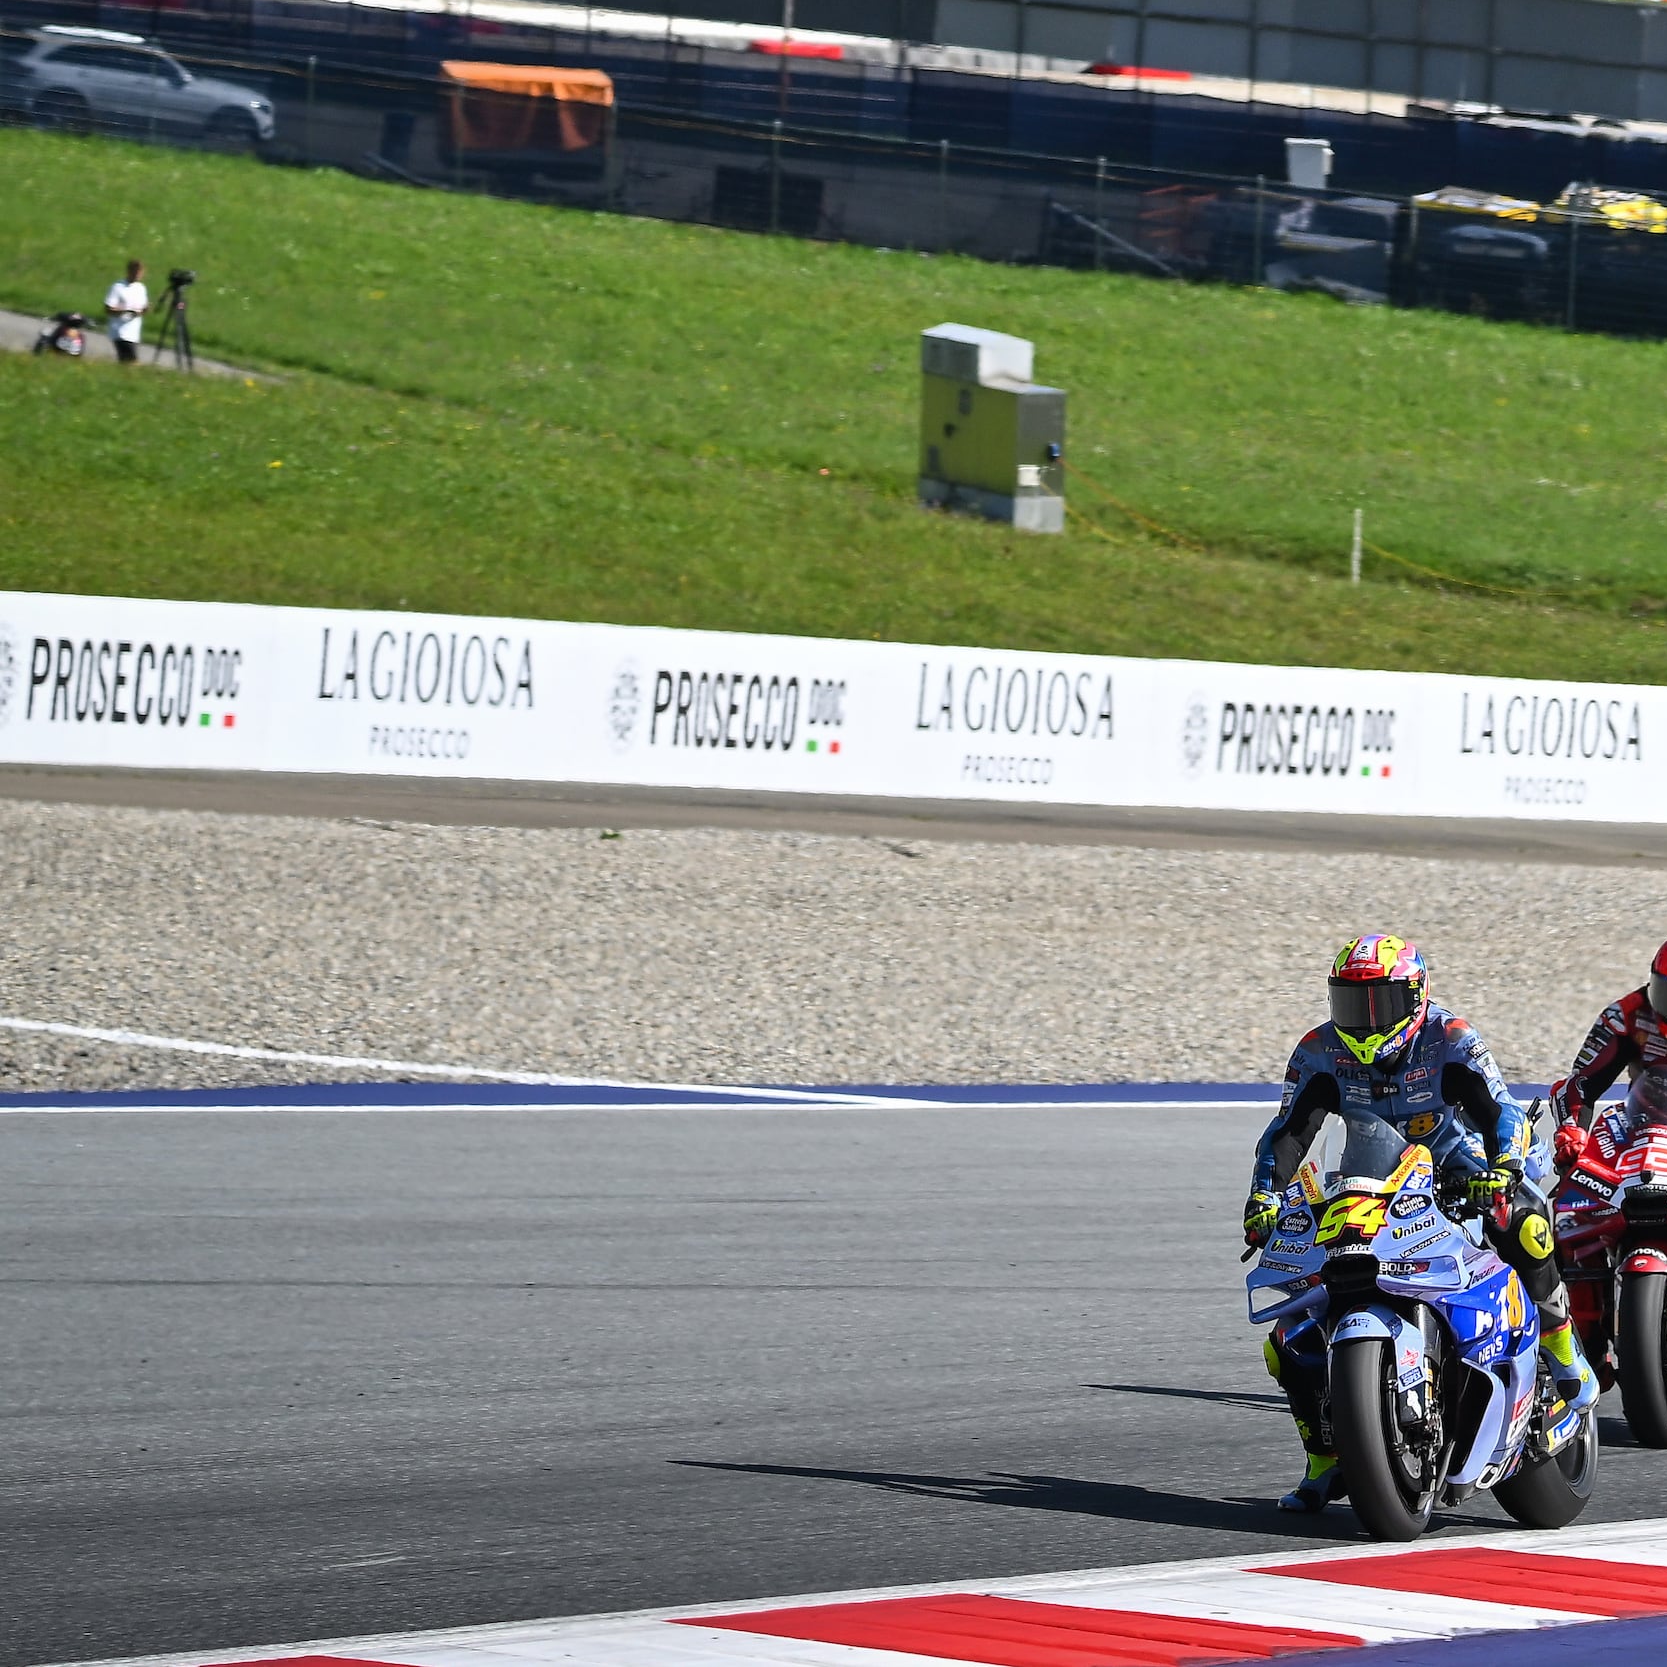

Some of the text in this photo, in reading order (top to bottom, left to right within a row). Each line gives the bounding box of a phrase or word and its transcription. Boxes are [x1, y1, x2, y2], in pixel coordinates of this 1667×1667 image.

[27, 637, 243, 728] PROSECCO DOC
[649, 670, 846, 754] PROSECCO DOC
[368, 725, 470, 760] PROSECCO
[1217, 702, 1357, 778] PROSECCO
[962, 755, 1052, 786] PROSECCO
[1595, 1130, 1617, 1160] riello
[1570, 1169, 1613, 1197] Lenovo
[1313, 1195, 1389, 1247] 54
[1391, 1215, 1437, 1240] Unibat
[1270, 1239, 1311, 1255] Unibat
[1378, 1261, 1413, 1273] BOLD
[1472, 1265, 1497, 1285] DUCATI
